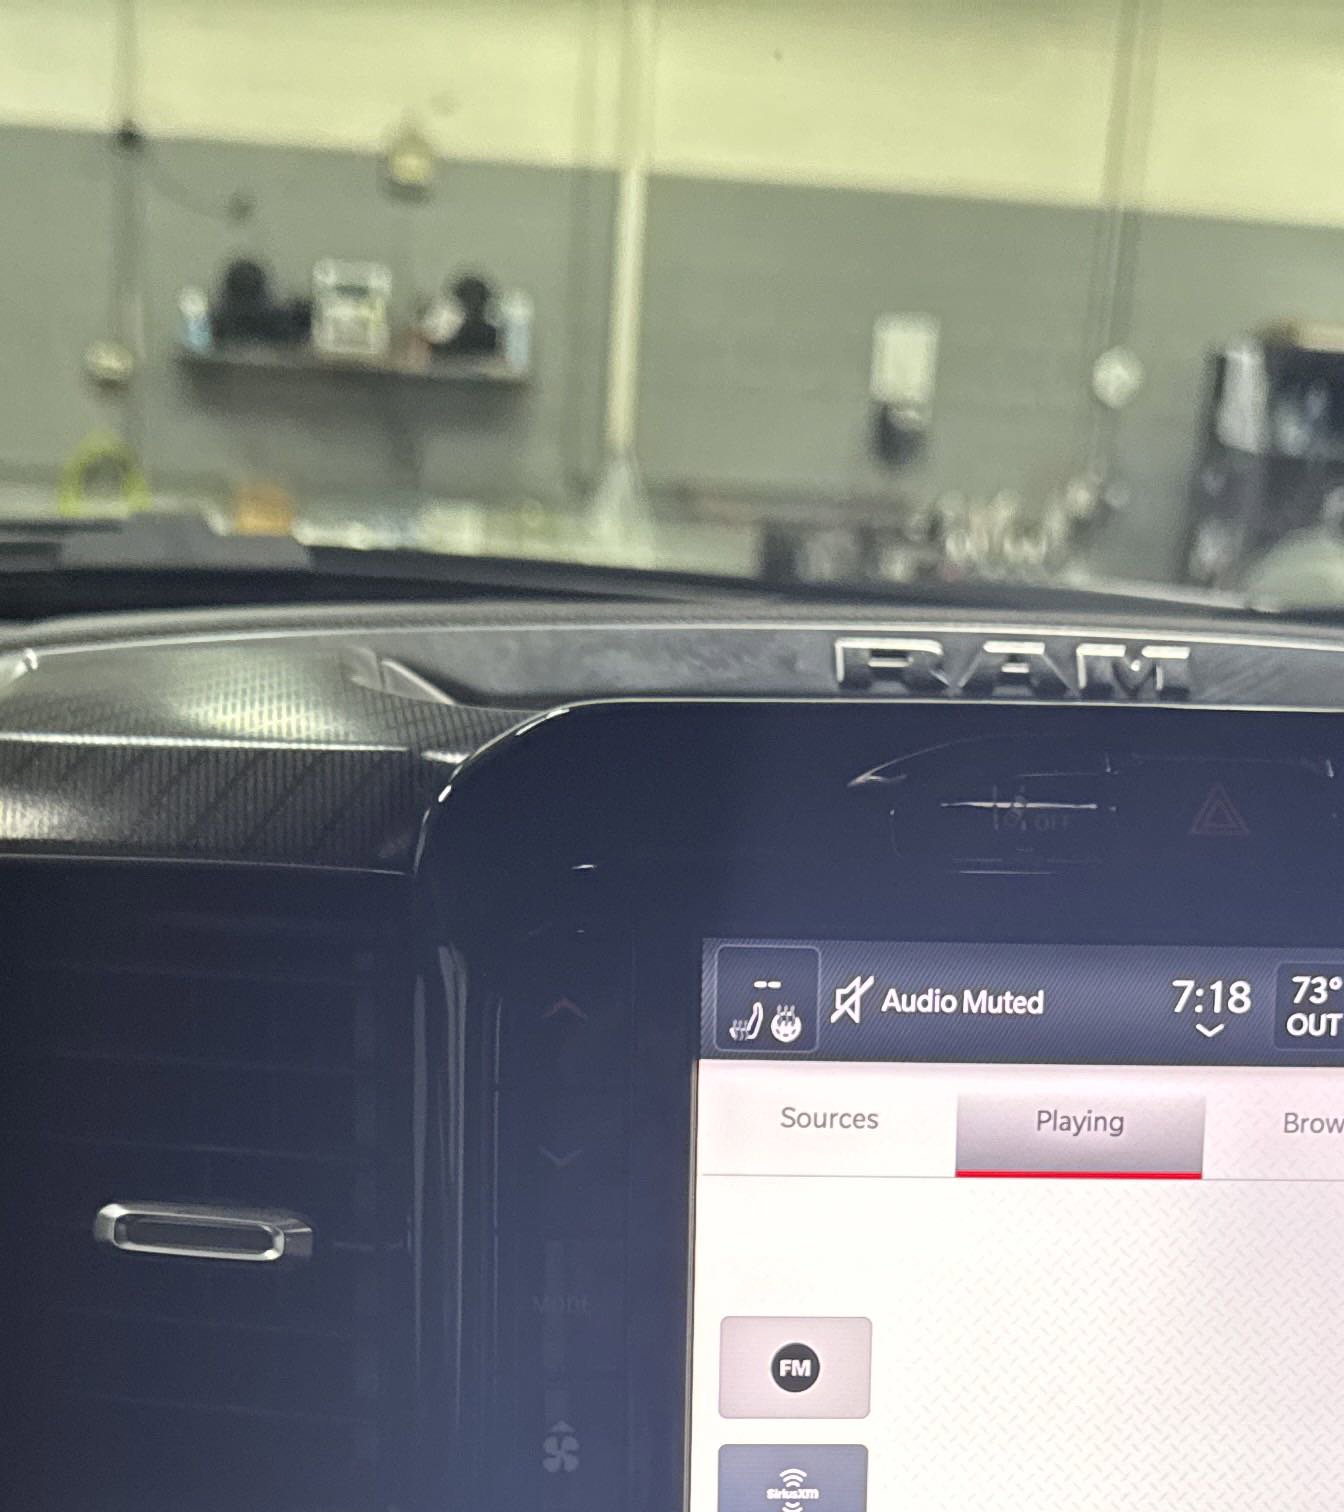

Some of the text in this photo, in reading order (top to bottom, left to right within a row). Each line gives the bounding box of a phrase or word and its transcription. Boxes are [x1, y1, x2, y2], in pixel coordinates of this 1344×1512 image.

[835, 637, 1190, 697] RAM
[881, 988, 1045, 1015] Audio Muted
[1171, 979, 1253, 1015] 7:18
[1291, 975, 1344, 1005] 73°
[1286, 1012, 1344, 1038] OUT
[780, 1106, 879, 1130] Sources
[1036, 1109, 1125, 1137] Playing
[778, 1359, 813, 1377] FM
